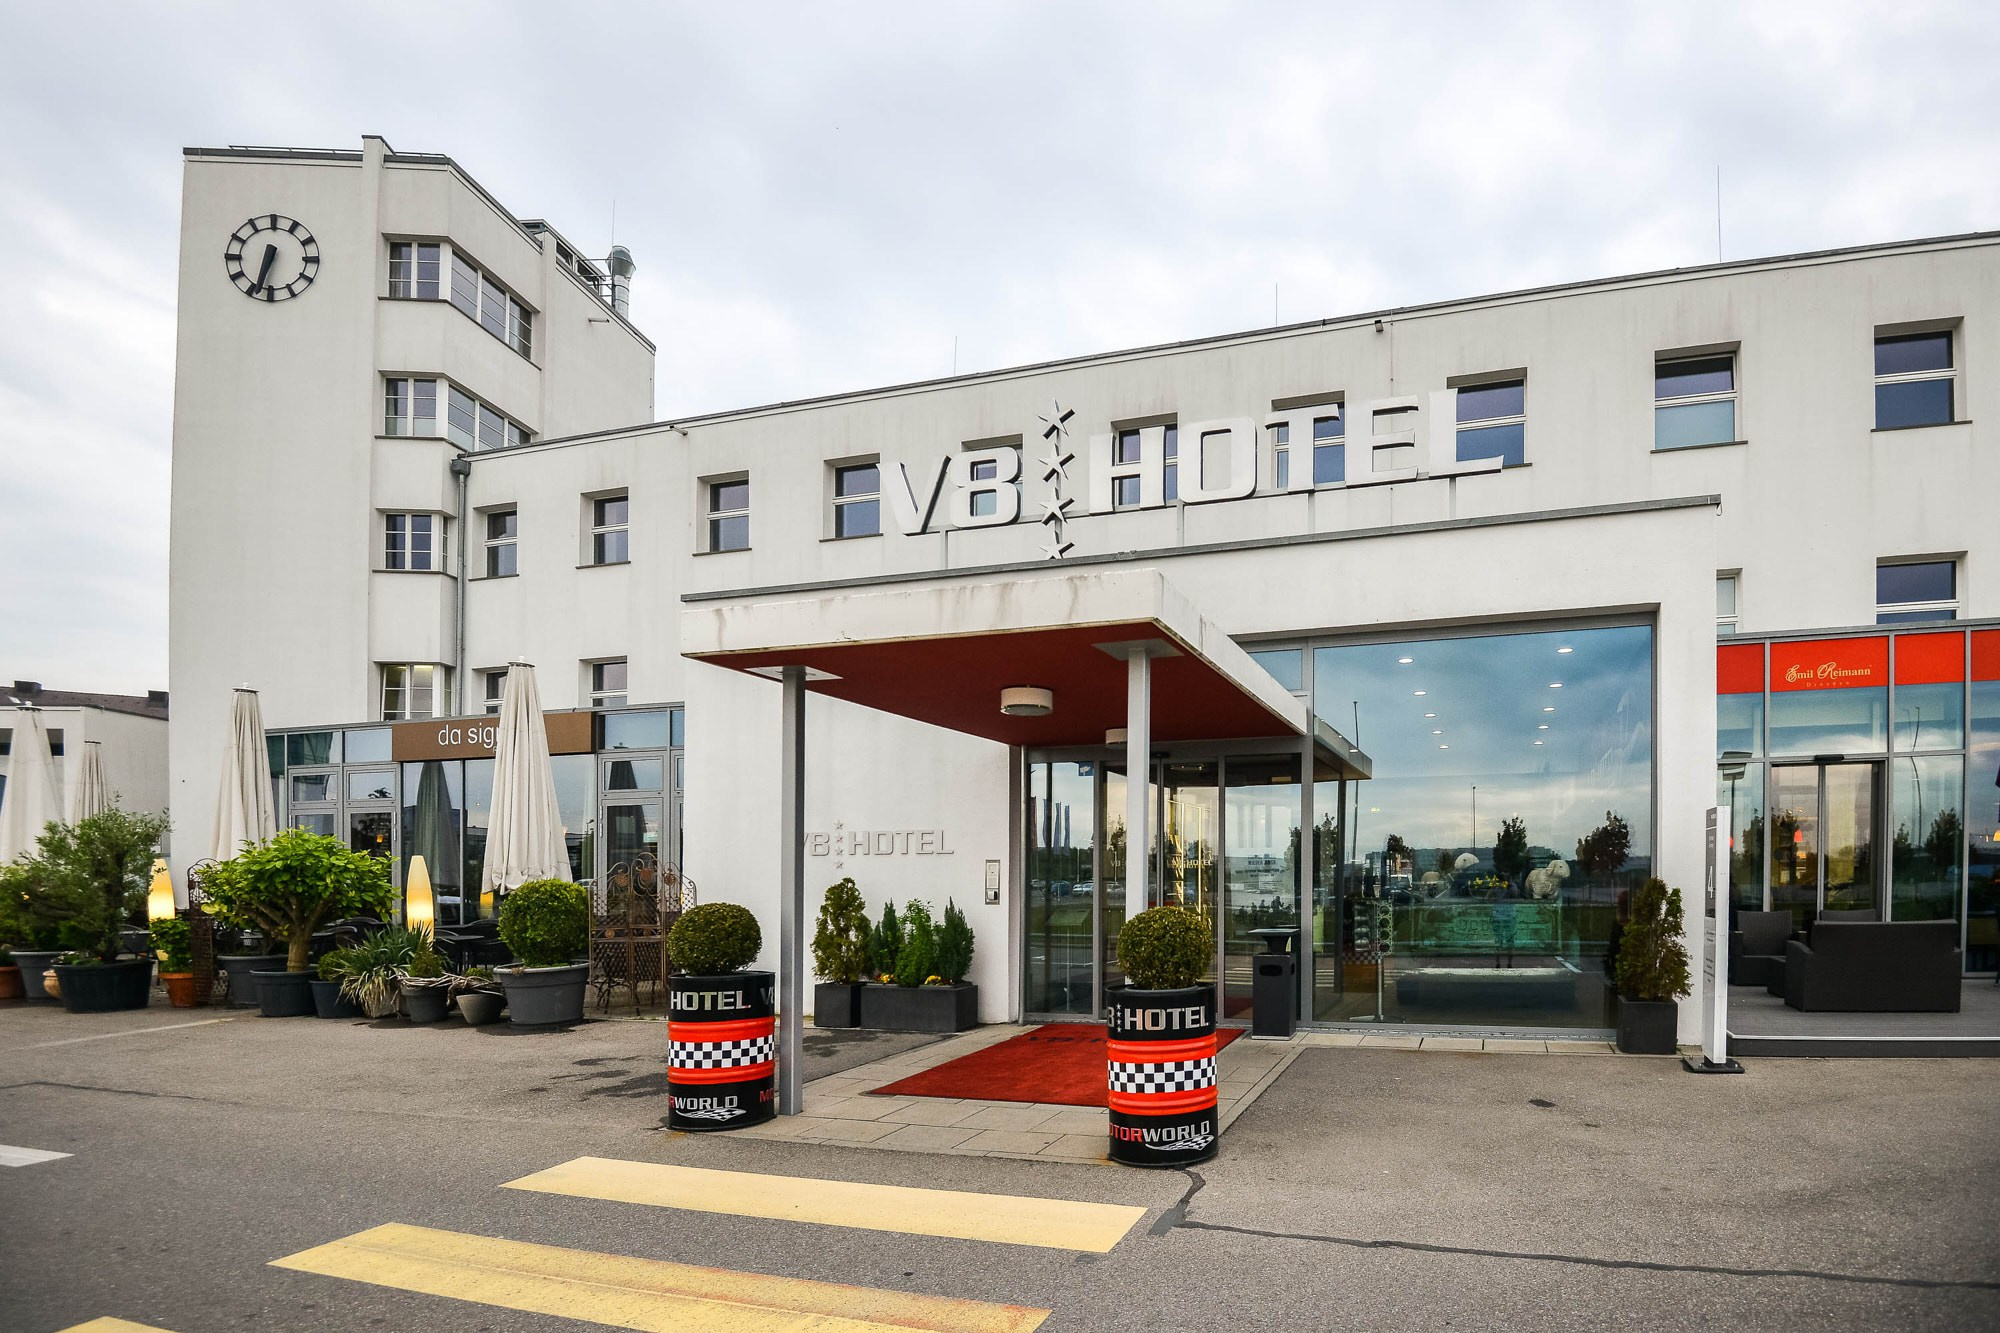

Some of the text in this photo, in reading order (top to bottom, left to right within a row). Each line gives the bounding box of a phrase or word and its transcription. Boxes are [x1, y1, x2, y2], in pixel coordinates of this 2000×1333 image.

[877, 388, 1505, 537] V8 HOTEL
[1785, 661, 1871, 682] Emil Reimann
[438, 722, 499, 749] da sig
[848, 830, 954, 856] HOTEL
[670, 990, 752, 1011] HOTEL
[1124, 1005, 1209, 1031] HOTEL
